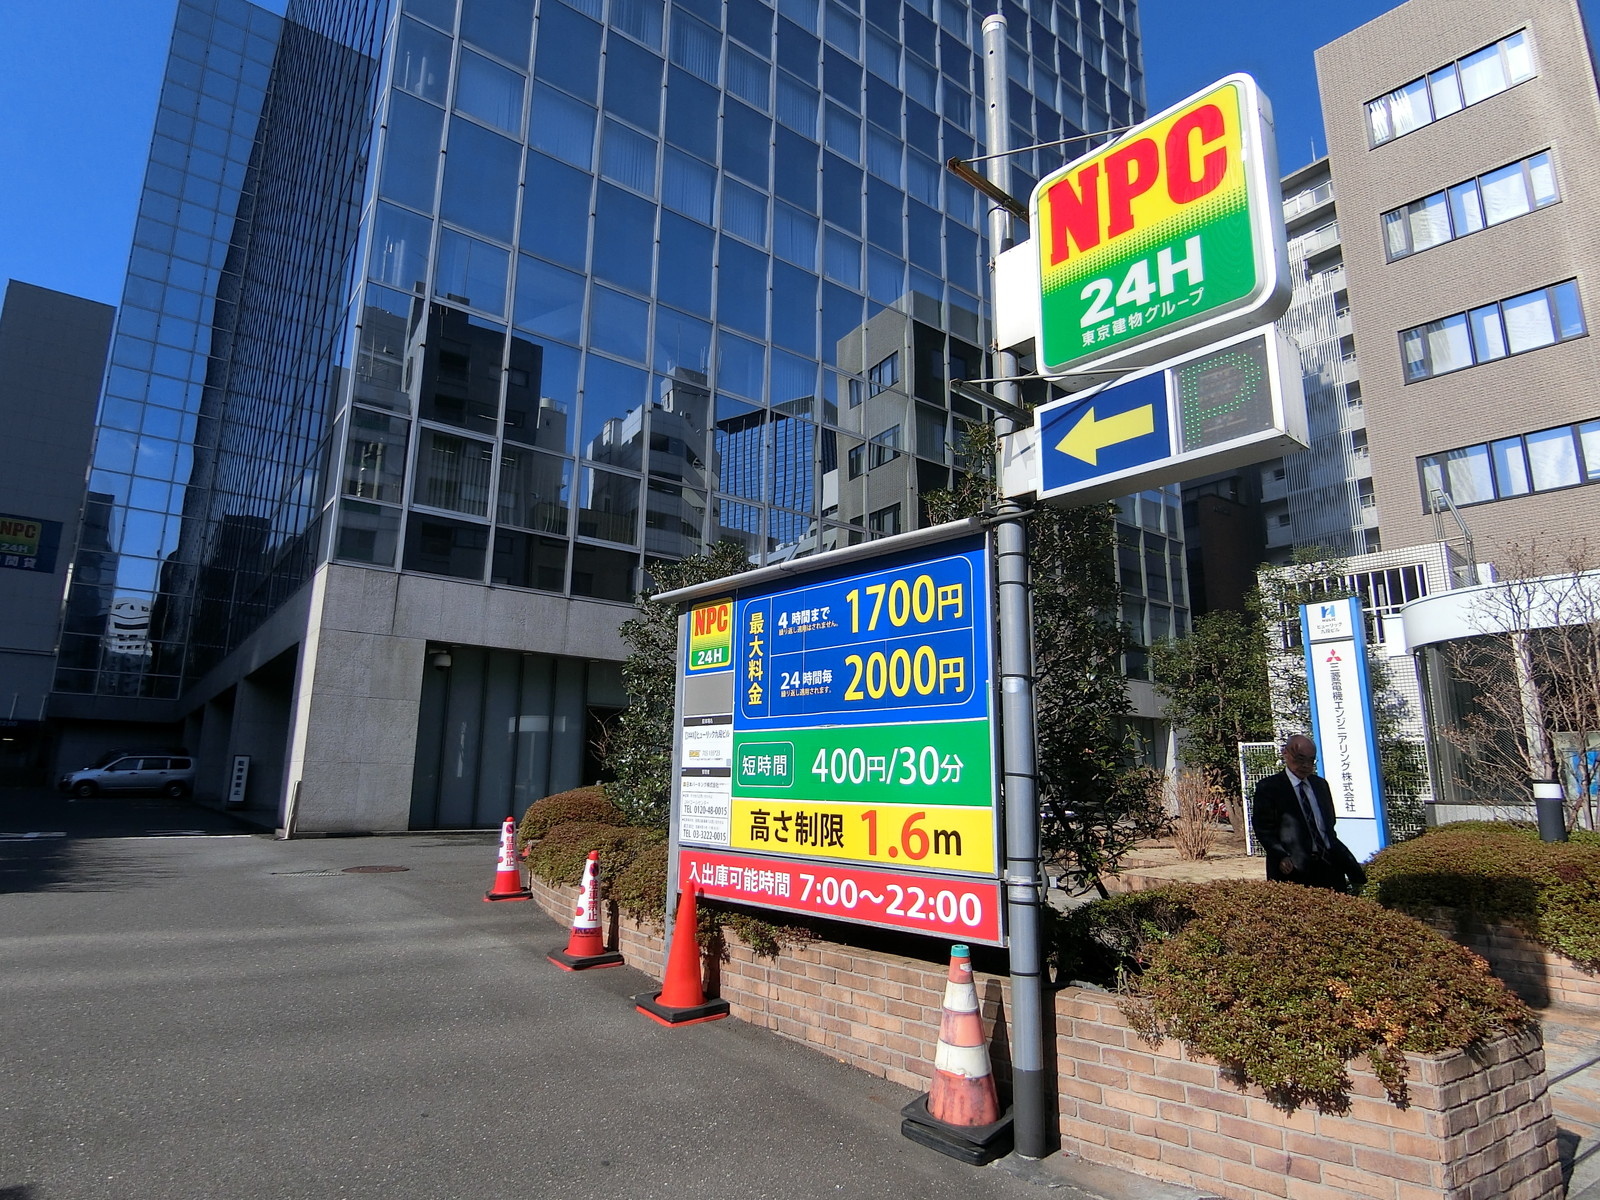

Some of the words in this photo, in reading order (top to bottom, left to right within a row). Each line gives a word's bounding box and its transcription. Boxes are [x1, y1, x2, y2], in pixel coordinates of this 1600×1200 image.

[1047, 103, 1228, 267] NPC
[1079, 235, 1204, 329] 24H
[1082, 287, 1204, 348] 東京建物グループ
[1180, 351, 1262, 450] P
[0, 520, 36, 539] NPC
[694, 604, 728, 637] NPC
[845, 574, 963, 634] 1700円
[697, 647, 723, 665] 24H
[748, 611, 764, 705] 最大料金
[844, 645, 965, 701] 2000円
[1329, 662, 1356, 812] 三菱電機エンジニアリング株式会社
[742, 755, 788, 777] 短時間
[684, 804, 692, 814] TEL
[506, 836, 515, 867] 駐車禁止
[683, 828, 691, 838] TEL
[750, 808, 845, 849] 高さ制限
[861, 809, 962, 860] 1.6m
[588, 879, 599, 922] 駐車禁止
[689, 860, 791, 898] 入出庫可能時間
